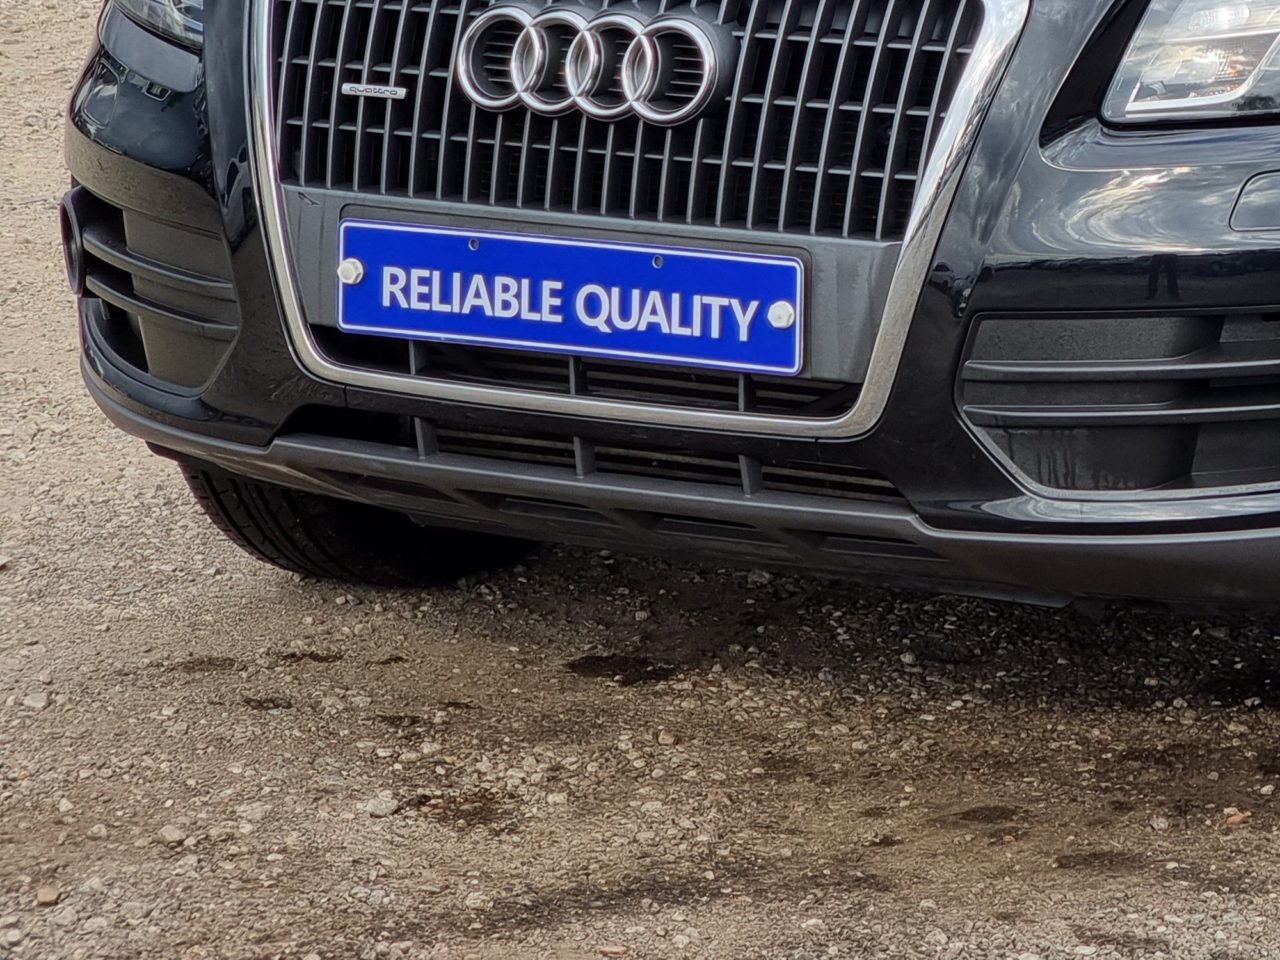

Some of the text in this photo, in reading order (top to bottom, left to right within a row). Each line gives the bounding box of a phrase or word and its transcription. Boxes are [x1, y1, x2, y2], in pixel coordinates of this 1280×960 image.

[349, 86, 398, 96] quattro
[382, 268, 759, 342] RELIABLE QUALITY
